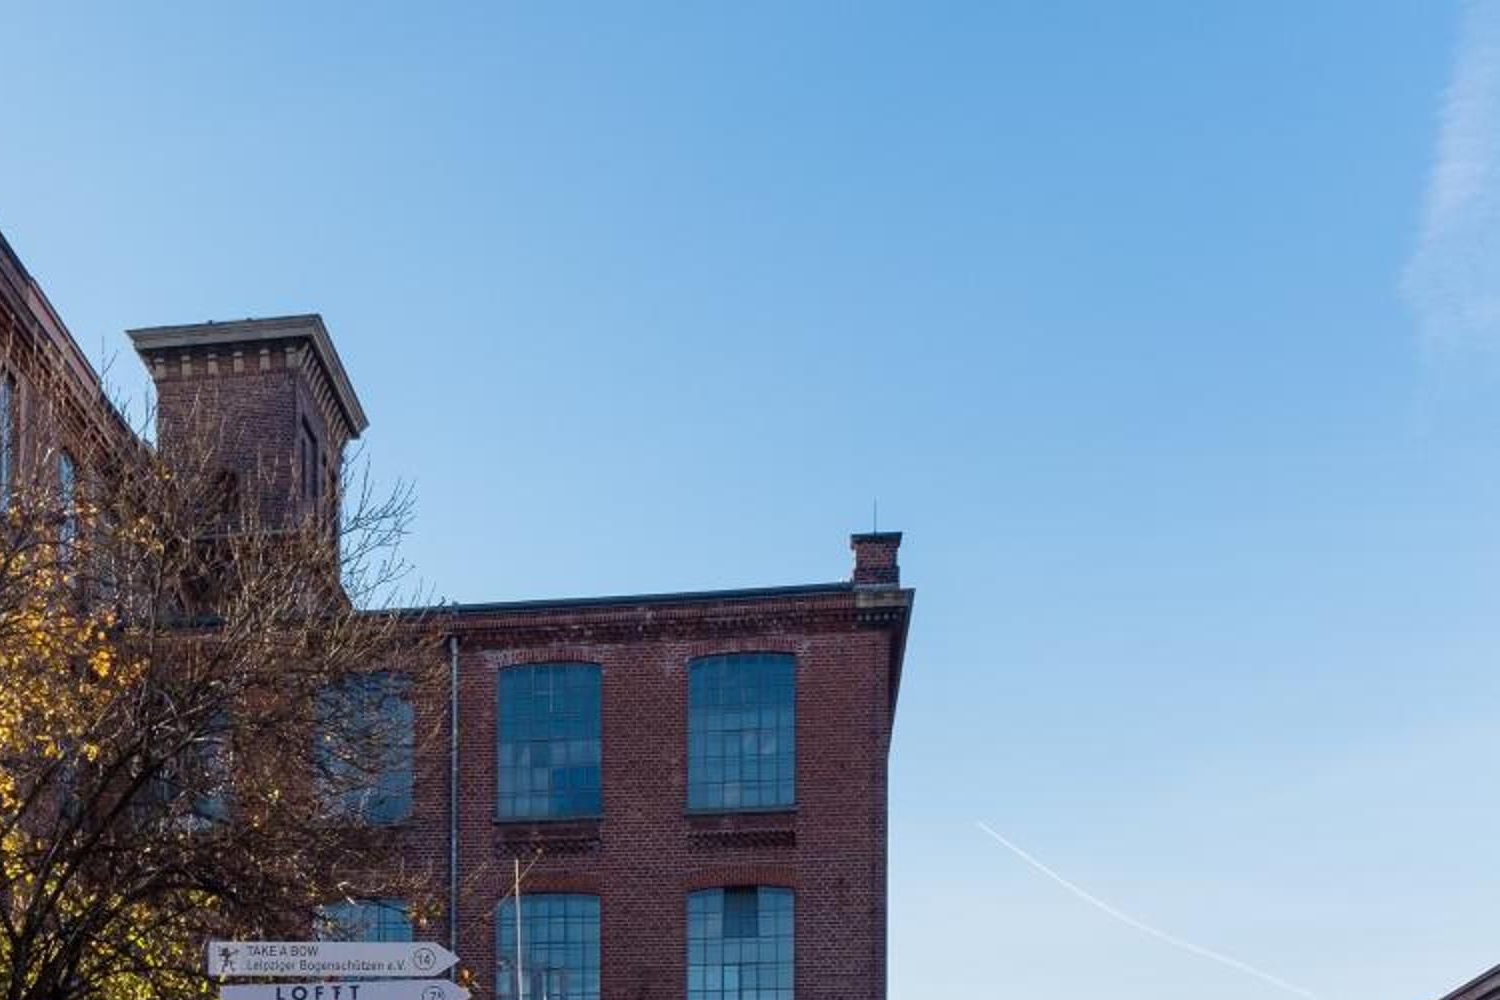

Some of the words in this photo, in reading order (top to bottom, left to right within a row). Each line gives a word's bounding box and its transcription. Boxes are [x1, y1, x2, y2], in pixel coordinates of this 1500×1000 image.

[246, 945, 277, 957] TAKE
[280, 945, 288, 957] A
[290, 945, 319, 957] BOW
